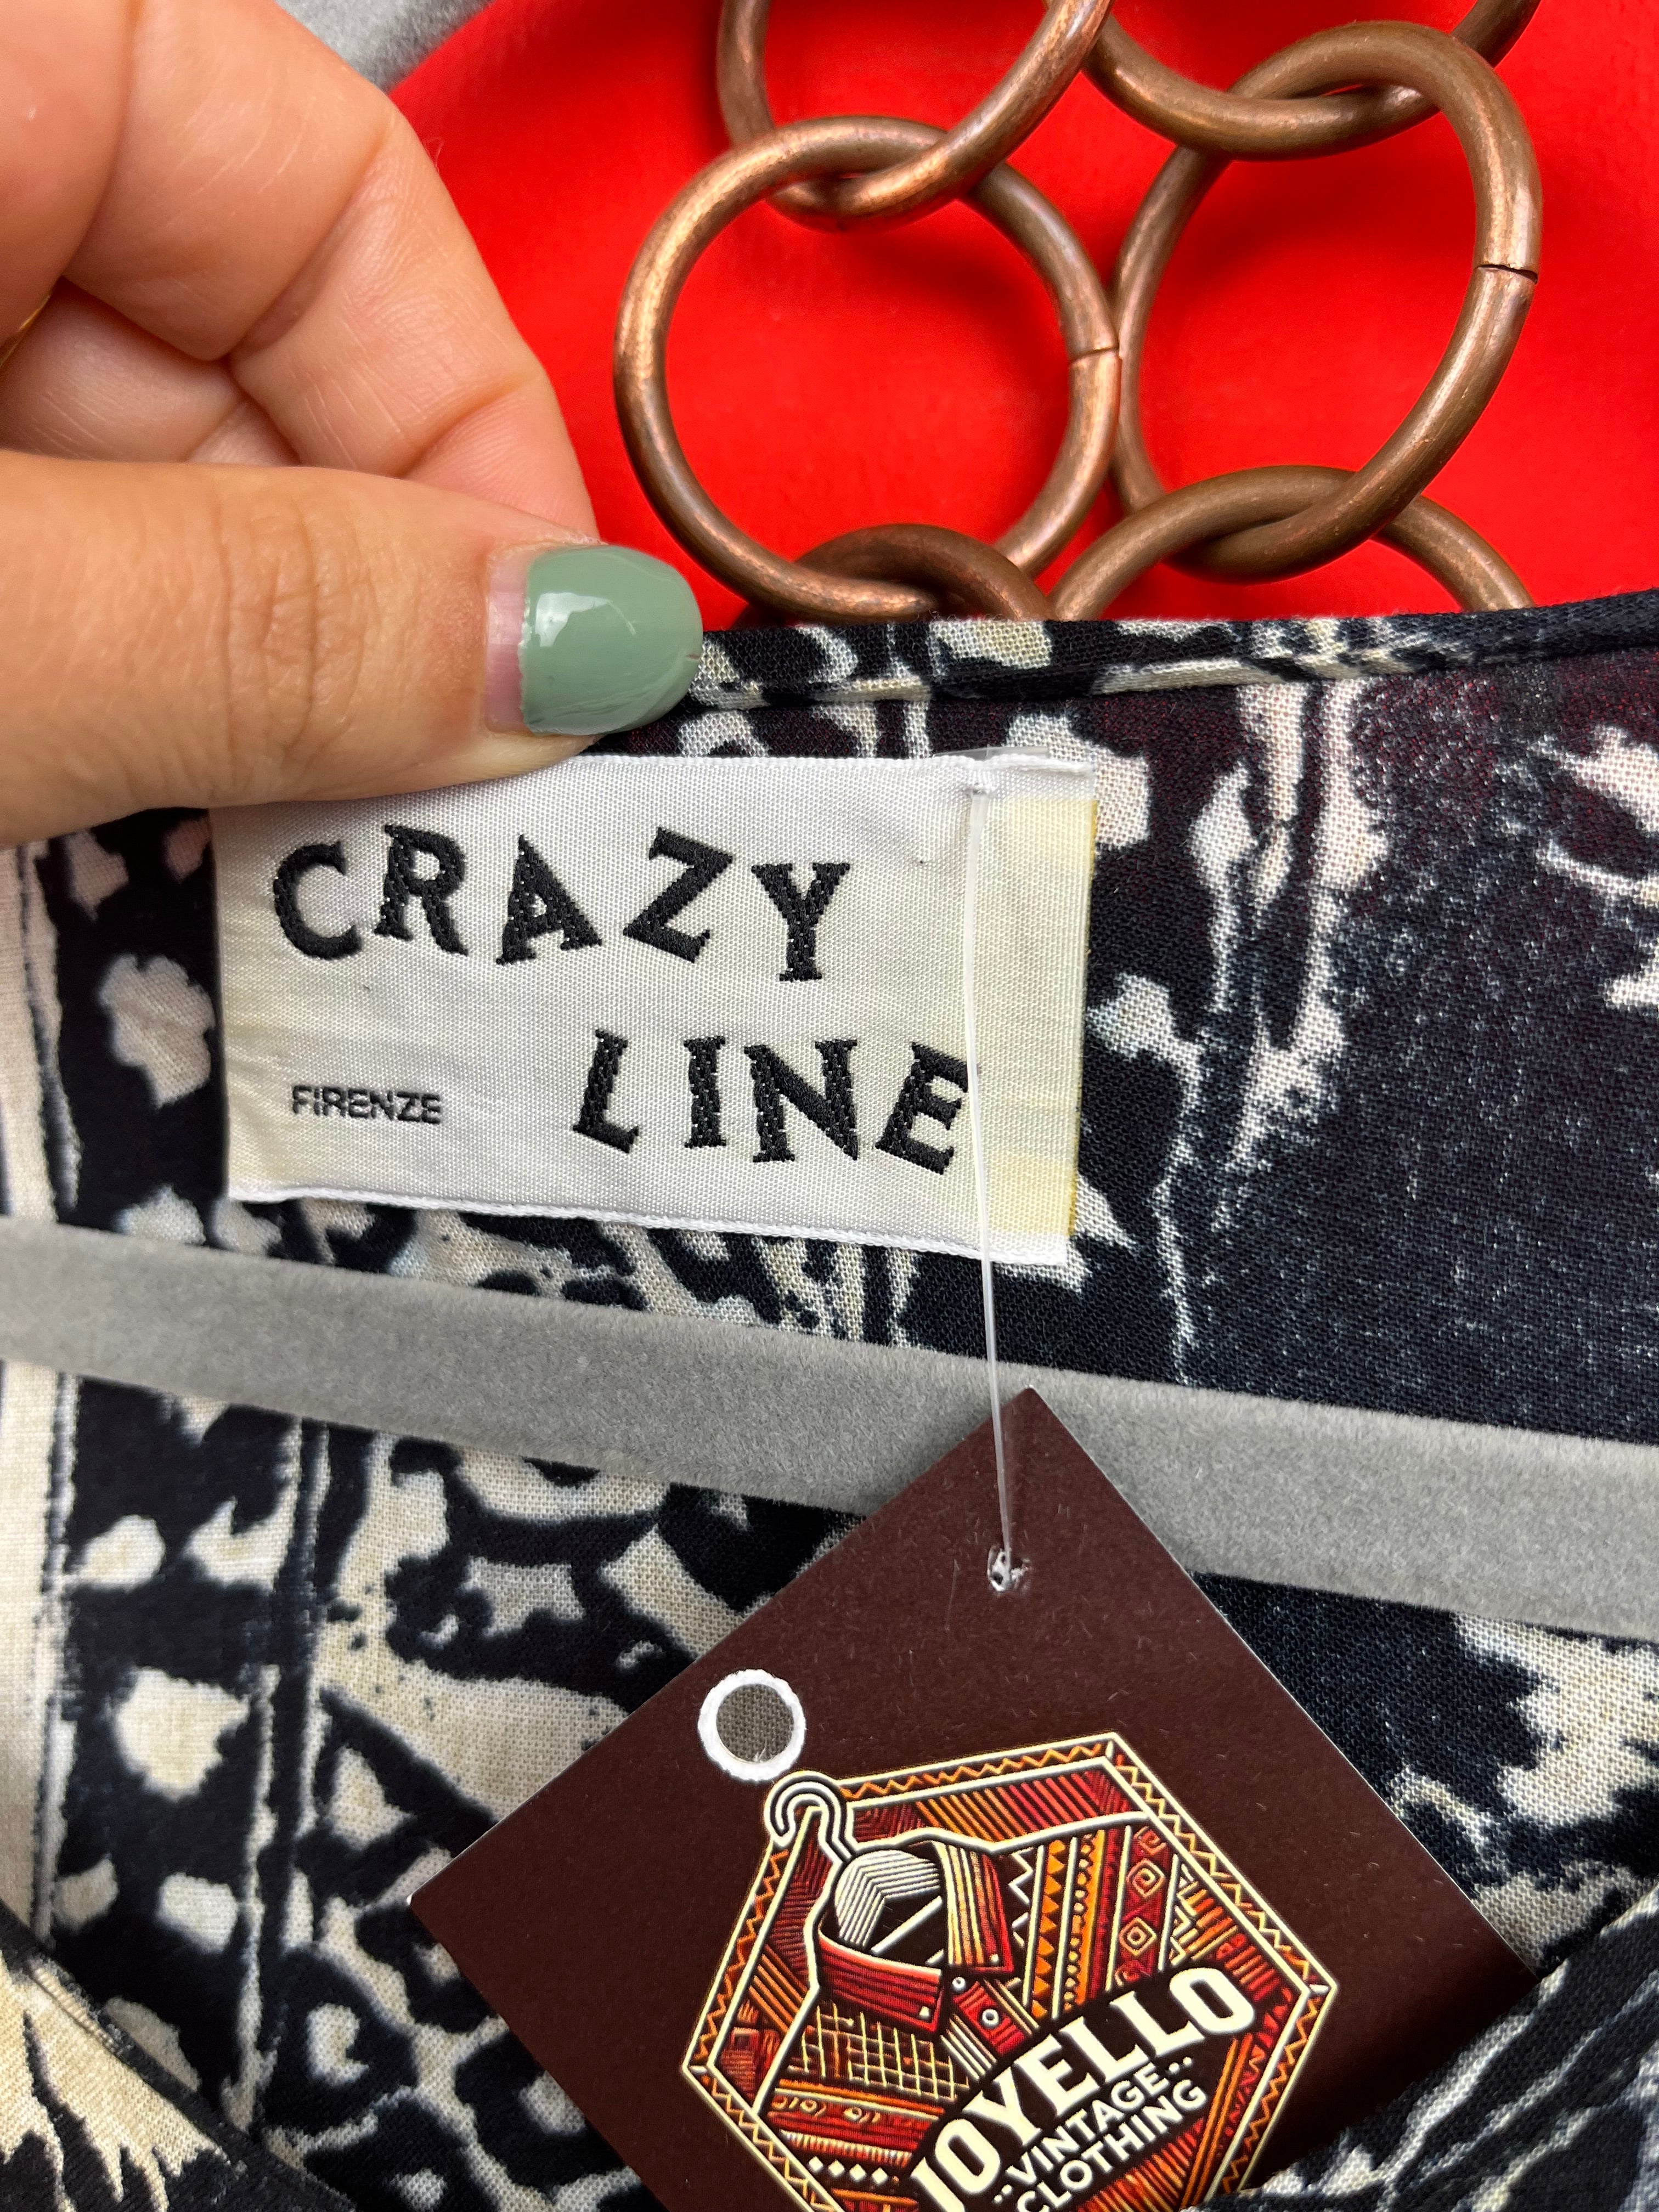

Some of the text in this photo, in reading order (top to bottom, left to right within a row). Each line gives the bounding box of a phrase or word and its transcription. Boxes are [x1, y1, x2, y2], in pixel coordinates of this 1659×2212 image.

[274, 823, 850, 982] CRAZY
[292, 1084, 441, 1125] FIRENZE
[573, 1029, 969, 1175] LINE
[1005, 2062, 1170, 2185] VINTAGE
[1016, 2079, 1207, 2212] CLOTHING
